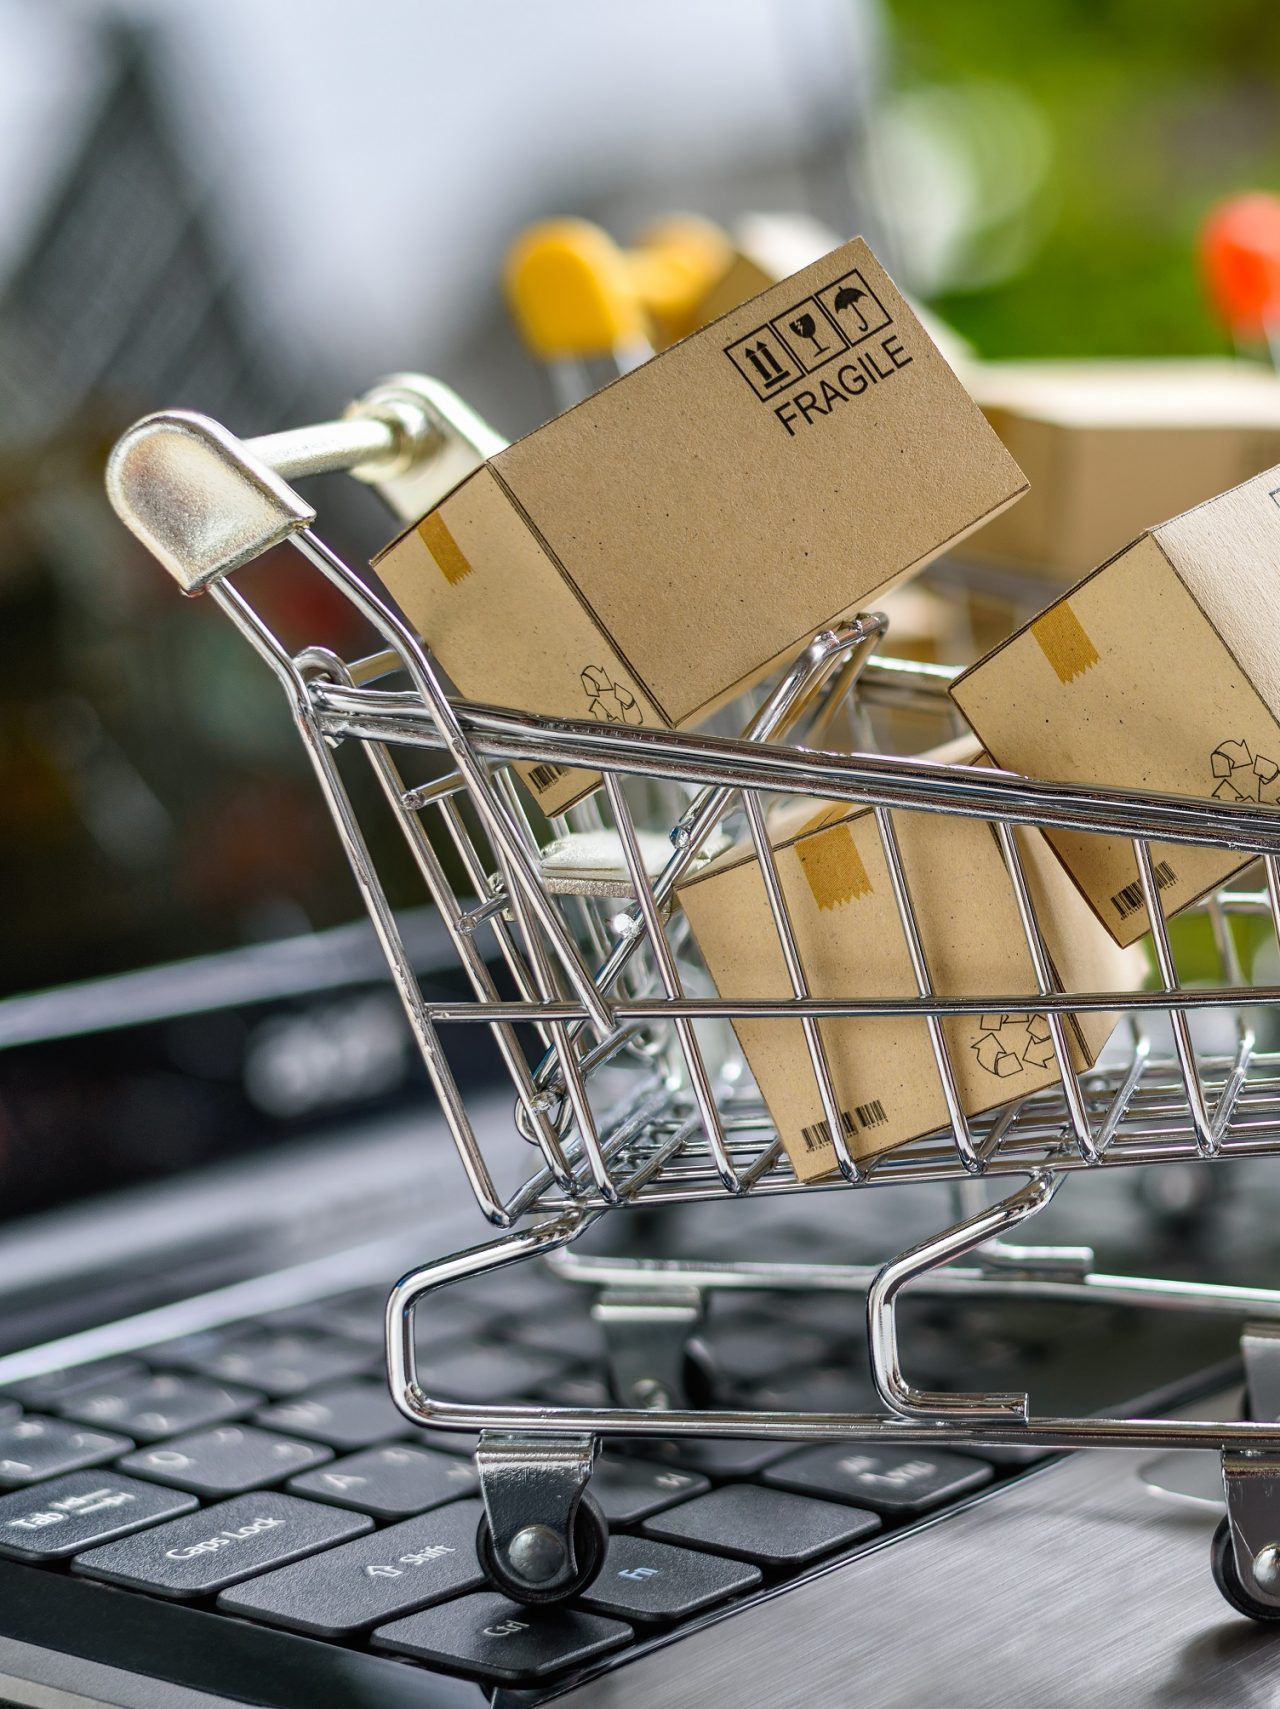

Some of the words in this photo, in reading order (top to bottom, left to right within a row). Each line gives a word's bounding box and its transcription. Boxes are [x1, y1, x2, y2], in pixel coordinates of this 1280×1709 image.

[773, 335, 914, 437] FRAGILE
[321, 1473, 367, 1490] A
[8, 1511, 67, 1530] Tab
[165, 1536, 231, 1559] Caps
[220, 1517, 287, 1540] Lock
[399, 1544, 457, 1566] Shift
[616, 1567, 659, 1581] Fn
[482, 1619, 531, 1636] Ctrl
